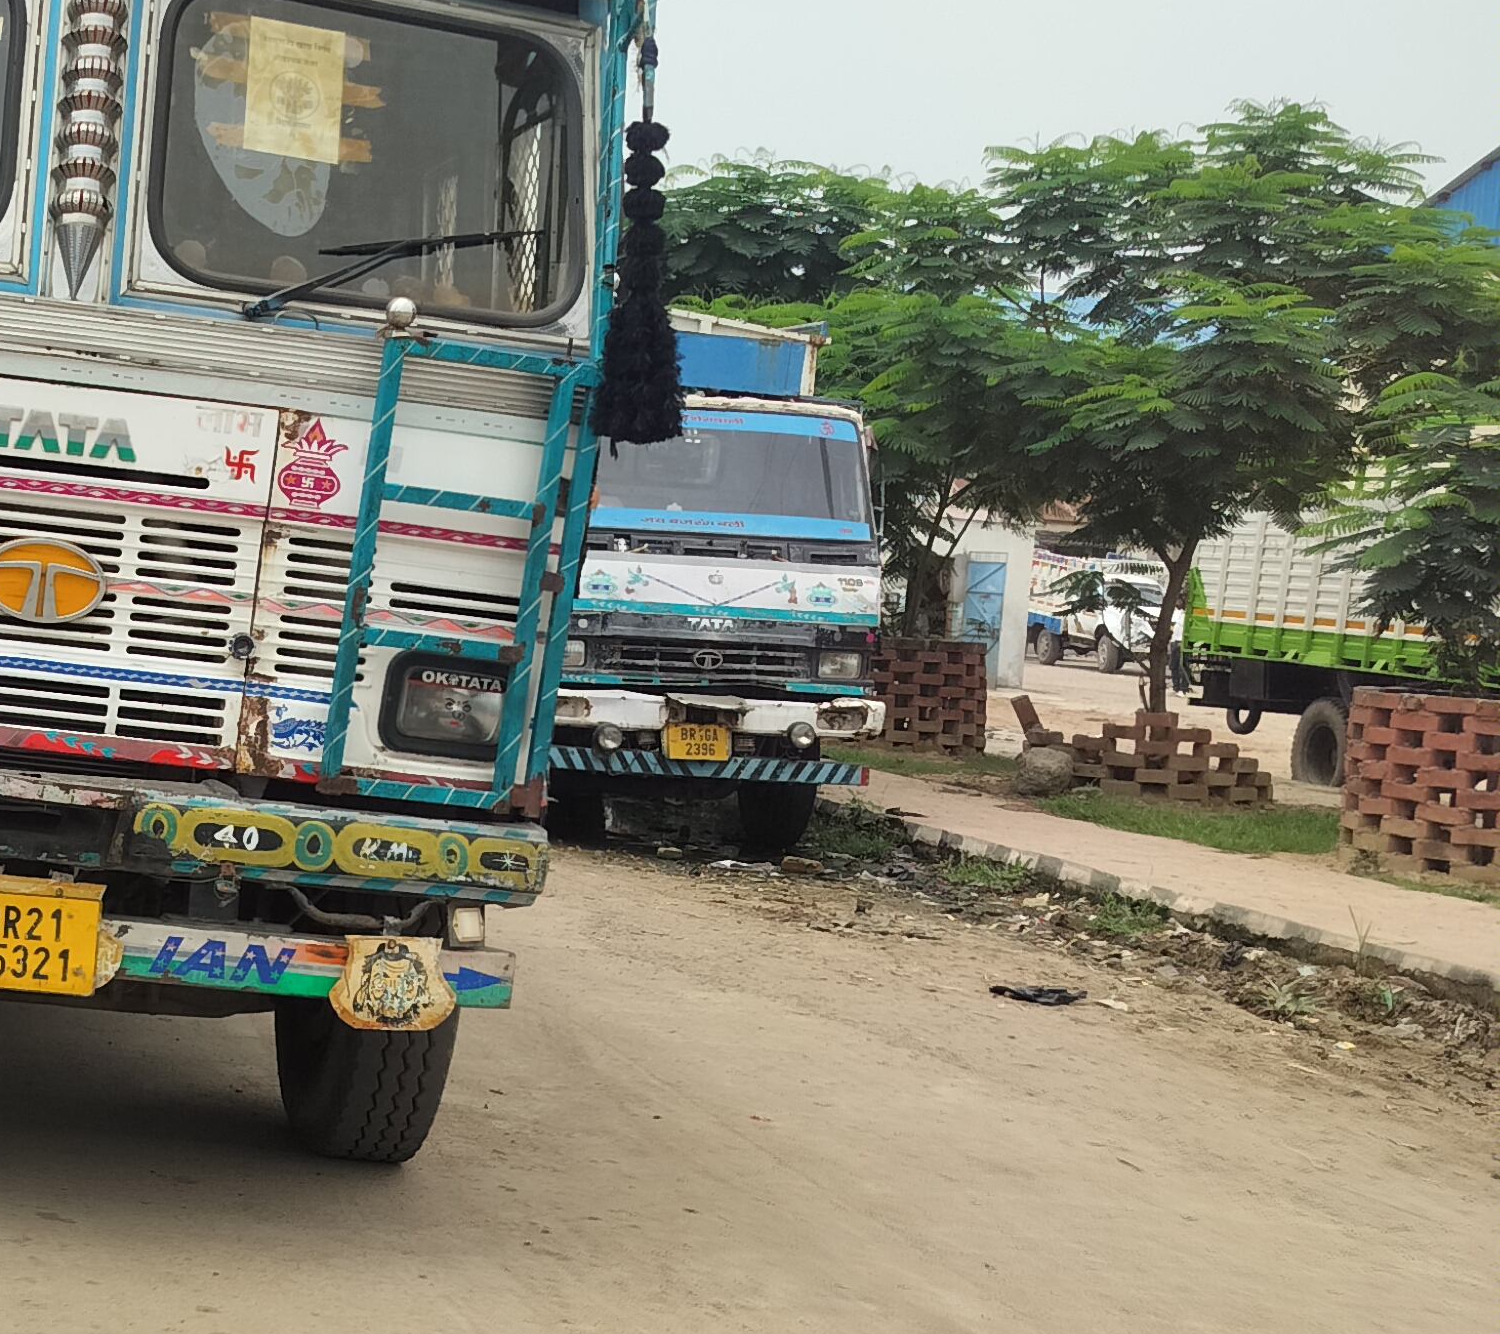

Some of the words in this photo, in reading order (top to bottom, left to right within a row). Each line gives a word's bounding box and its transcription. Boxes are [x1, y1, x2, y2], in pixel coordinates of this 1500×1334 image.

[687, 617, 734, 631] TATA
[459, 675, 502, 692] TATA
[685, 742, 716, 756] 2396
[213, 824, 259, 851] 40
[148, 935, 296, 985] IAN
